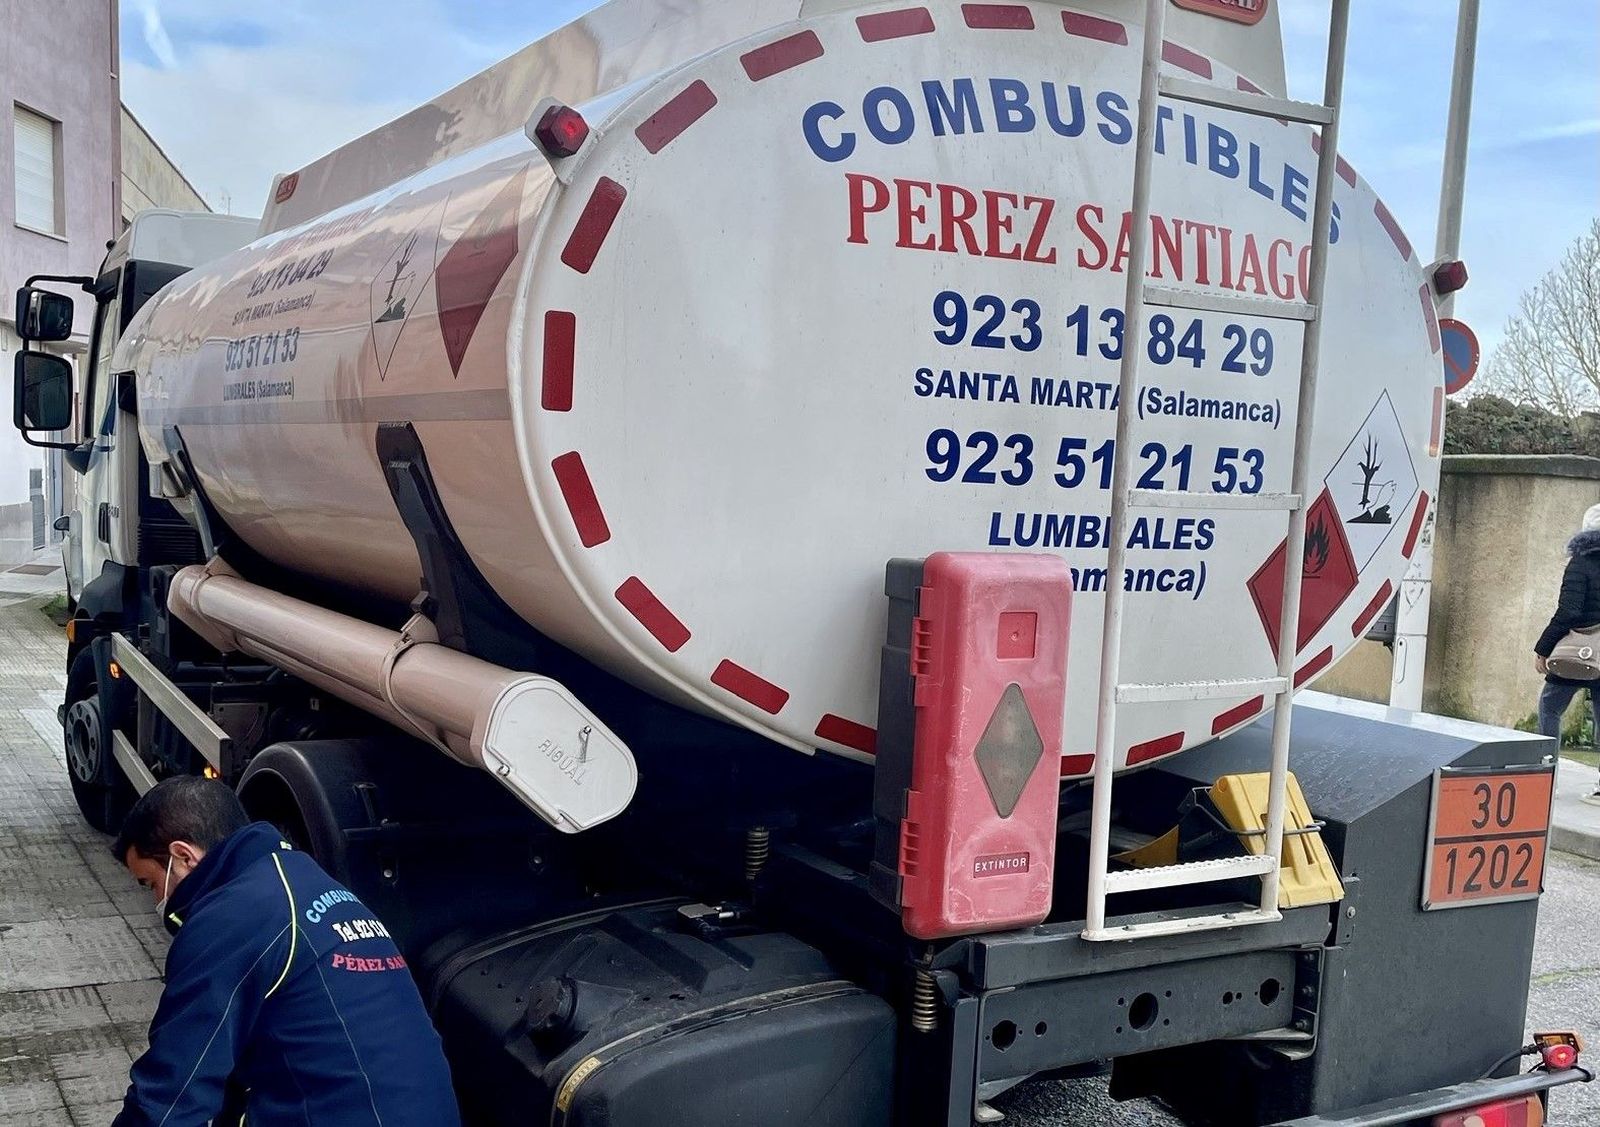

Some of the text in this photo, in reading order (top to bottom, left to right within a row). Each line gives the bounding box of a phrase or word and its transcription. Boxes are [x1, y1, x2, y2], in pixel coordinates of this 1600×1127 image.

[845, 173, 1057, 265] PEREZ
[225, 326, 300, 372] 923 51 21 53
[932, 290, 1275, 377] 923 13 84 29
[913, 367, 1020, 404] SANTA
[1137, 386, 1282, 430] (Salamanca)
[925, 428, 1265, 494] 923 51 21 53
[1471, 781, 1517, 830] 30
[974, 857, 1027, 873] EXTINTOR
[1446, 842, 1533, 895] 1202
[332, 953, 386, 972] PÉREZ
